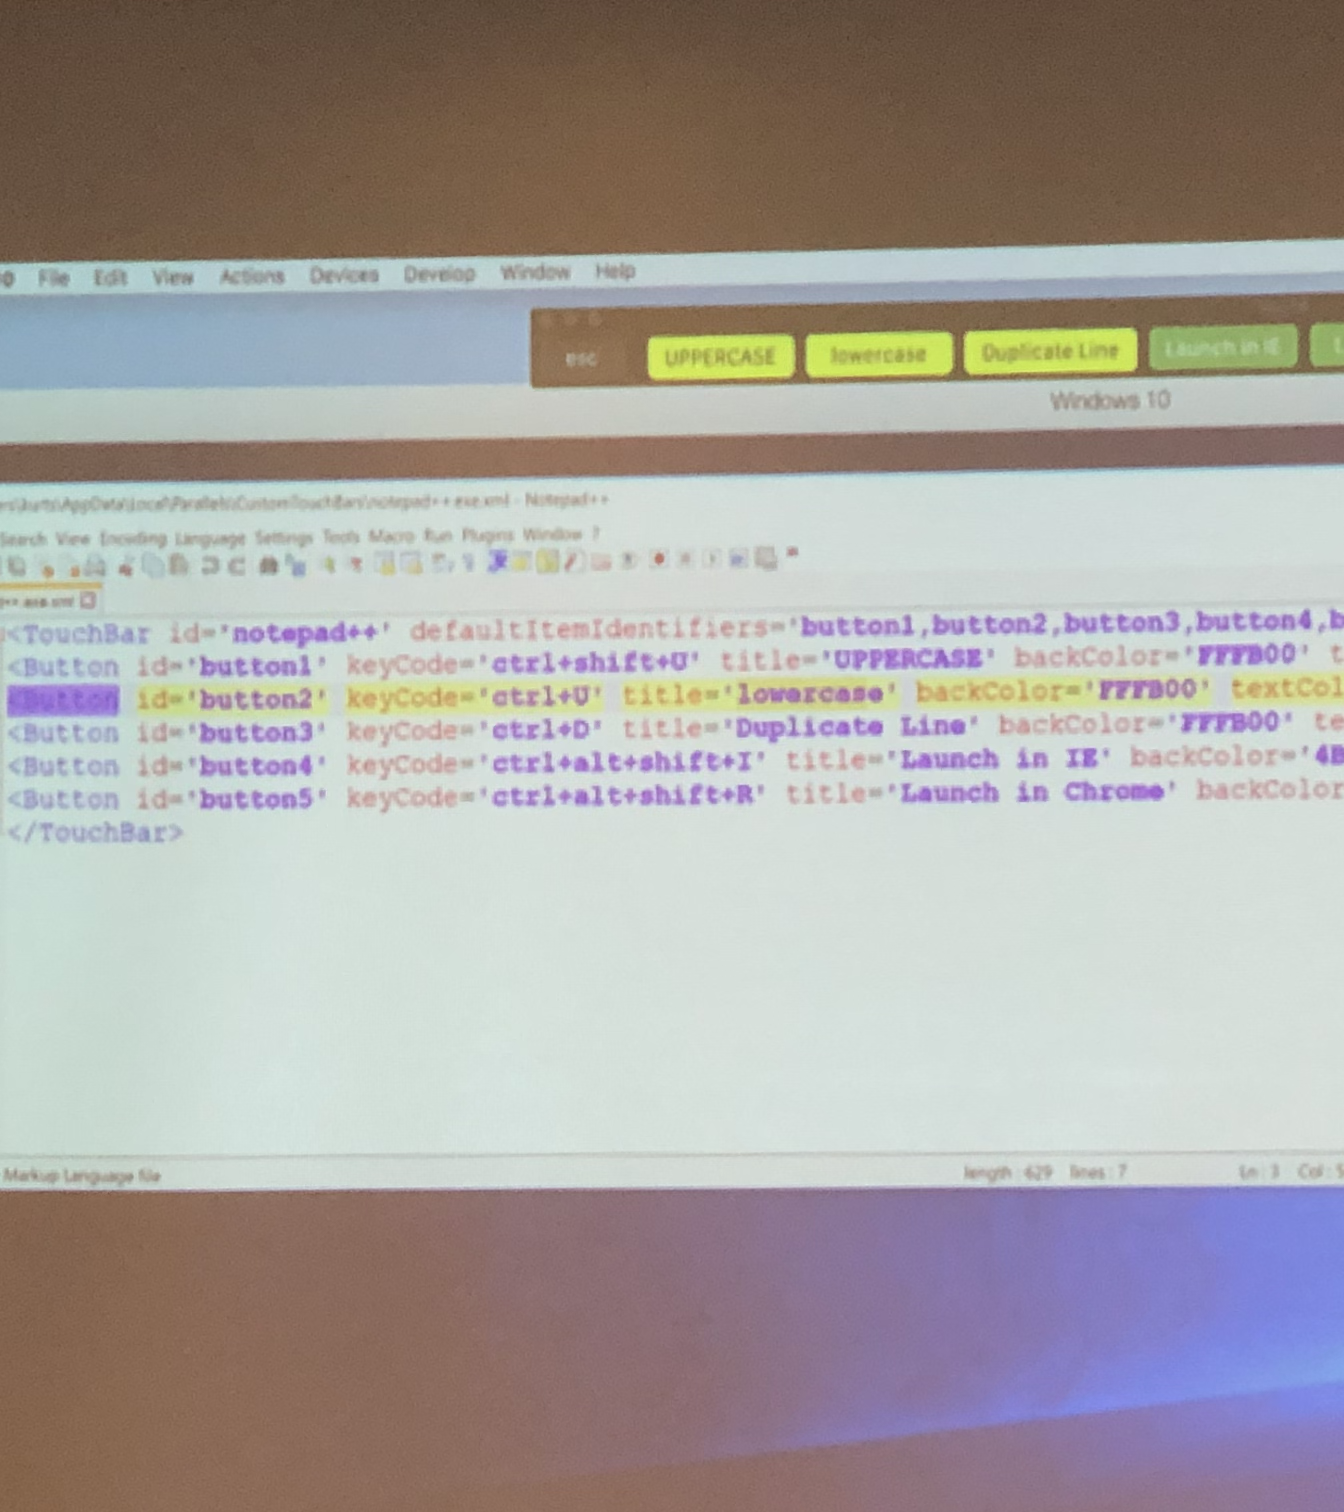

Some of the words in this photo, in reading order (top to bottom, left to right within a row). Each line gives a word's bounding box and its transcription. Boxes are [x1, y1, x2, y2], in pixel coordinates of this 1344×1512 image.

[37, 268, 71, 287] File
[93, 267, 129, 287] Edit
[152, 267, 194, 286] View
[219, 266, 286, 286] Actions
[309, 265, 380, 285] Devices
[403, 264, 477, 285] Develop
[500, 262, 572, 282] Window
[595, 262, 636, 282] Help
[664, 346, 777, 368] UPPERCASE
[830, 343, 927, 364] lowercase
[982, 338, 1074, 363] Duplicate
[1078, 340, 1119, 361] Line
[1165, 339, 1235, 359] Launch
[1050, 389, 1142, 411] Windows
[1146, 389, 1172, 410] 10
[0, 530, 48, 547] Search
[55, 530, 91, 546] View
[100, 530, 168, 549] Encoding
[174, 529, 246, 549] Language
[255, 528, 314, 548] Settings
[323, 528, 360, 544] Tools
[368, 527, 416, 544] Macro
[424, 526, 453, 543] Run
[461, 526, 515, 545] Plugins
[523, 526, 584, 542] Window
[7, 623, 151, 645] <TouchBar
[7, 656, 120, 678] <Button
[7, 722, 120, 744] <Button
[7, 756, 120, 778] <Button
[1015, 746, 1049, 769] in
[7, 789, 120, 811] <Button
[1015, 780, 1049, 803] in
[7, 820, 185, 845] </TouchBar>
[3, 1167, 57, 1186] Markup
[63, 1167, 135, 1186] Language
[138, 1167, 161, 1184] file
[963, 1163, 1013, 1184] length
